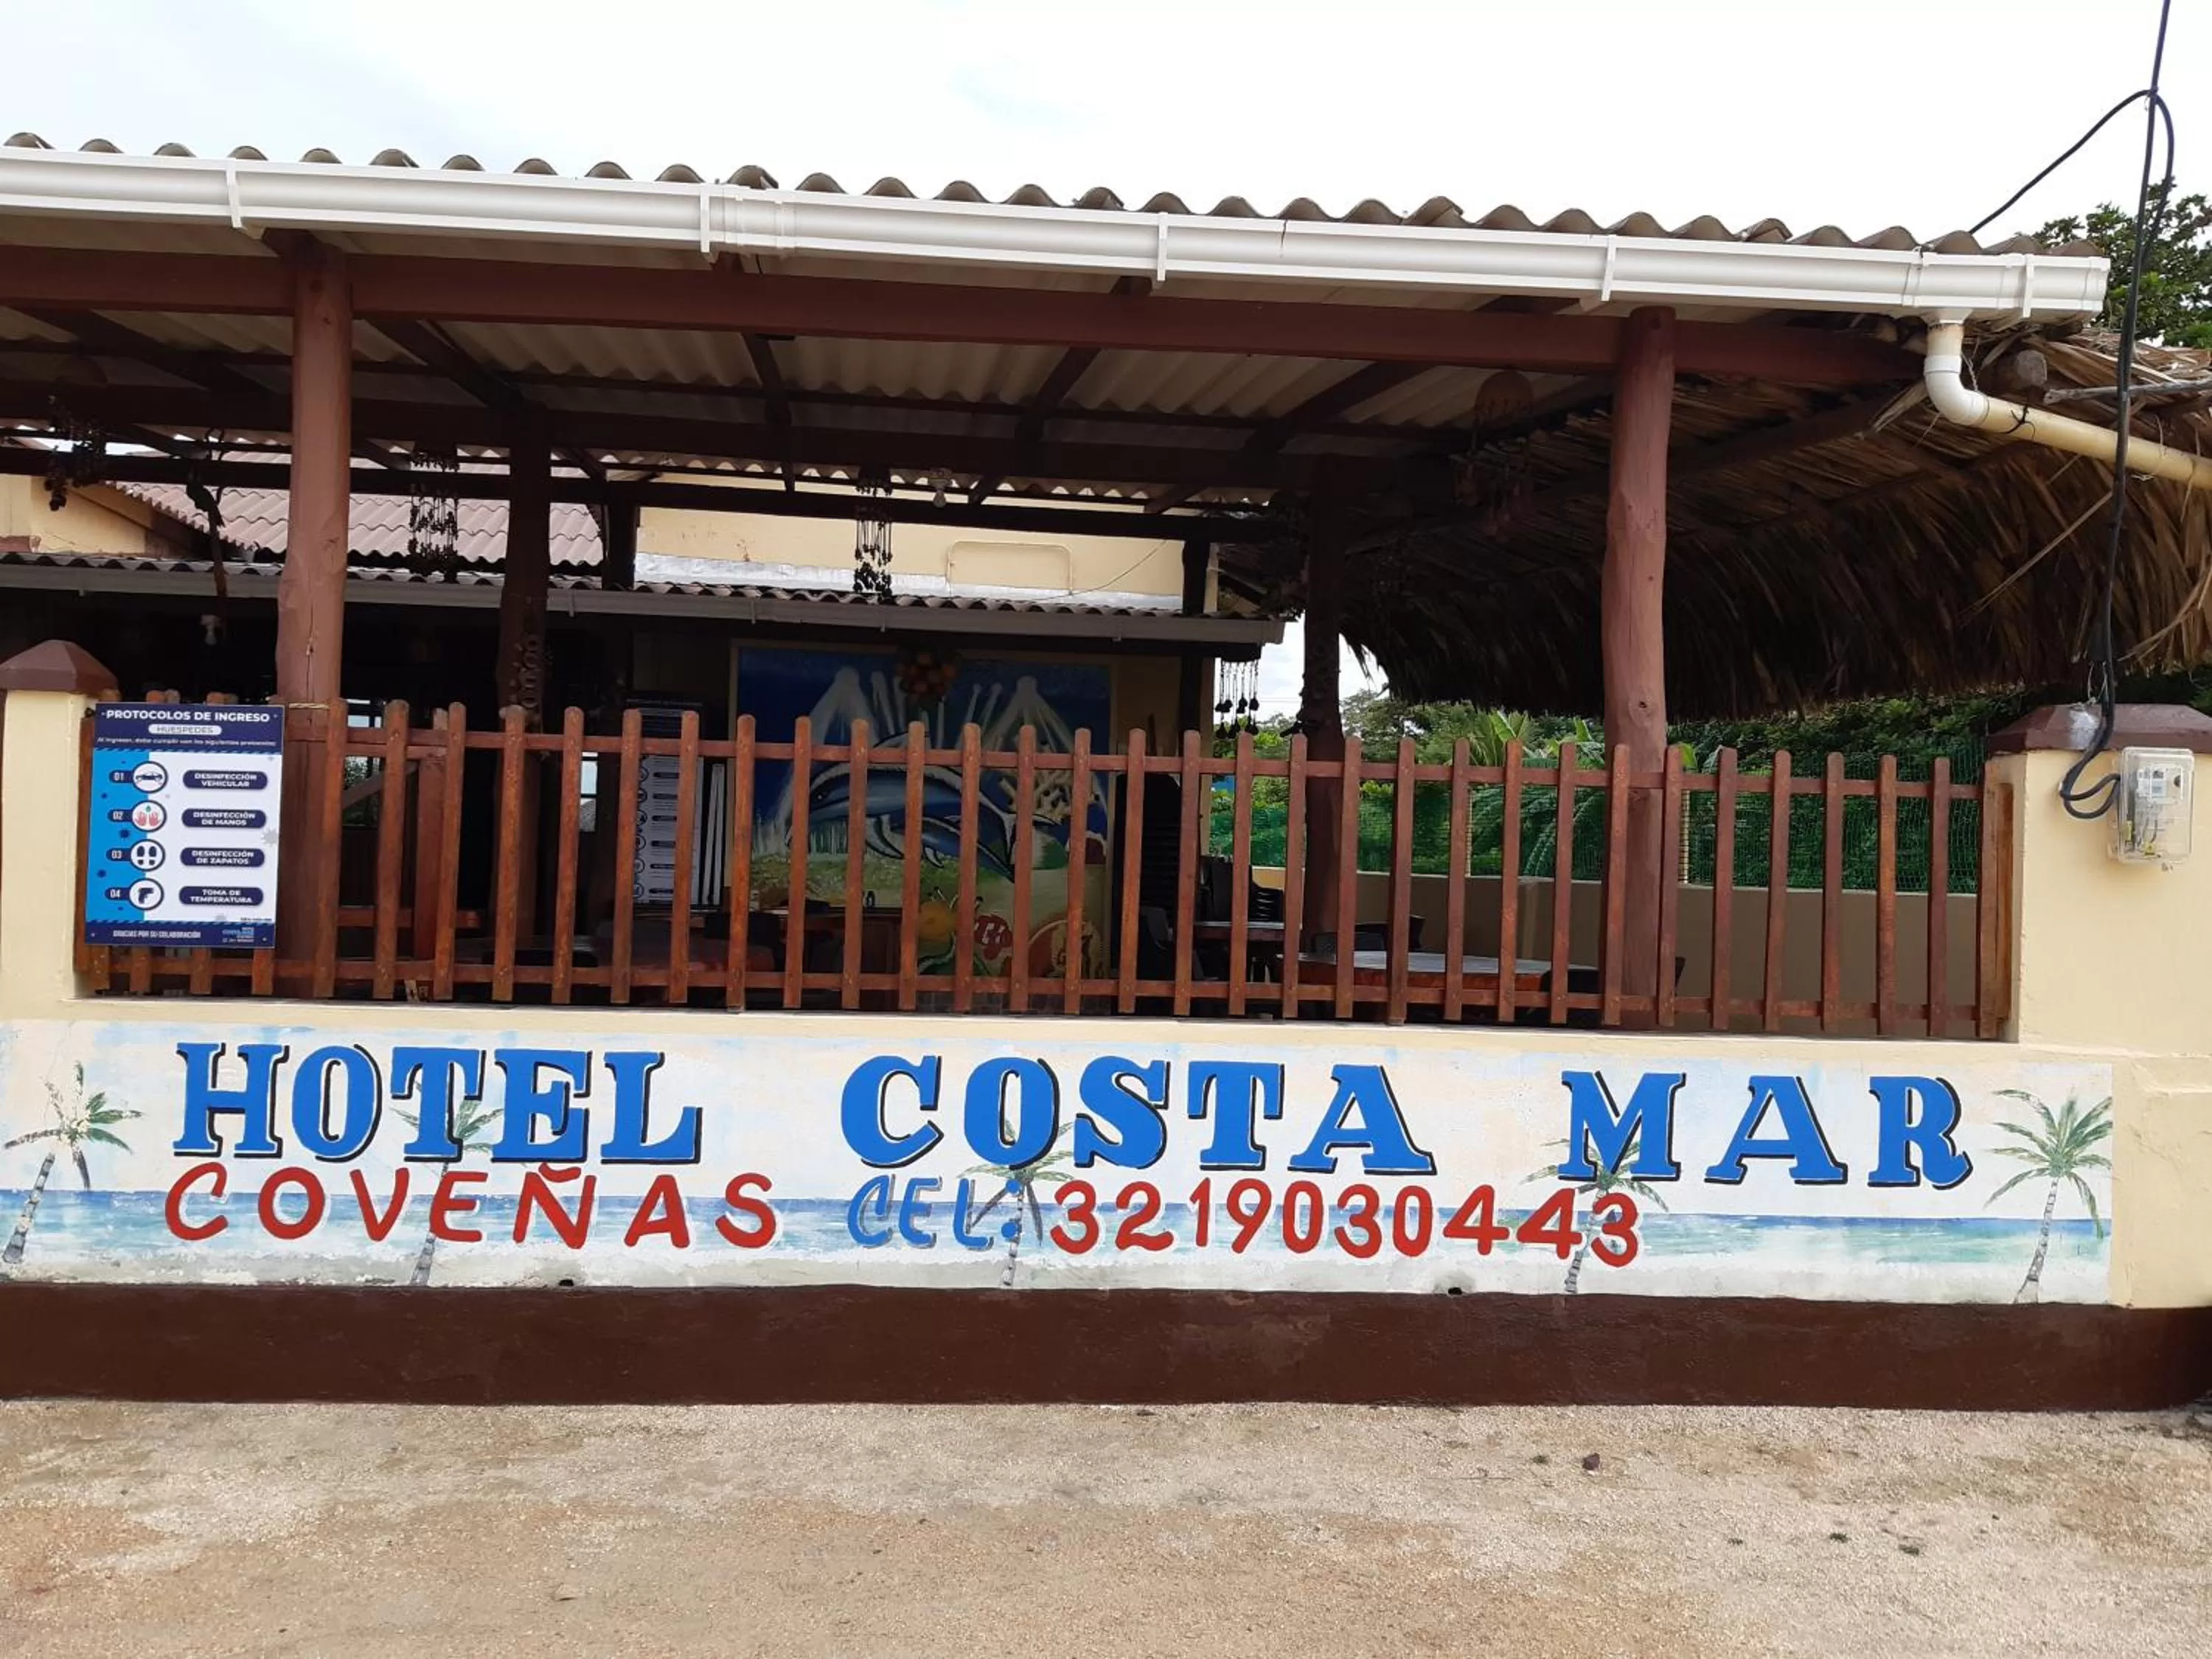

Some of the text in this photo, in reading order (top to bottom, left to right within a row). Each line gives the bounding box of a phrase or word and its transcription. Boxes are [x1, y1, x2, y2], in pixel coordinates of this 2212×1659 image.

[106, 710, 270, 723] PROTOCOLOS DE INGRESO
[114, 772, 125, 781] 01
[113, 810, 124, 821] 02
[192, 811, 256, 819] DESINFECCIÓN
[111, 850, 122, 860] 03
[110, 888, 121, 898] 04
[173, 1043, 1974, 1190] HOTEL COSTA MAR
[164, 1161, 776, 1250] COVEÑAS
[1049, 1178, 1640, 1267] 3219030443
